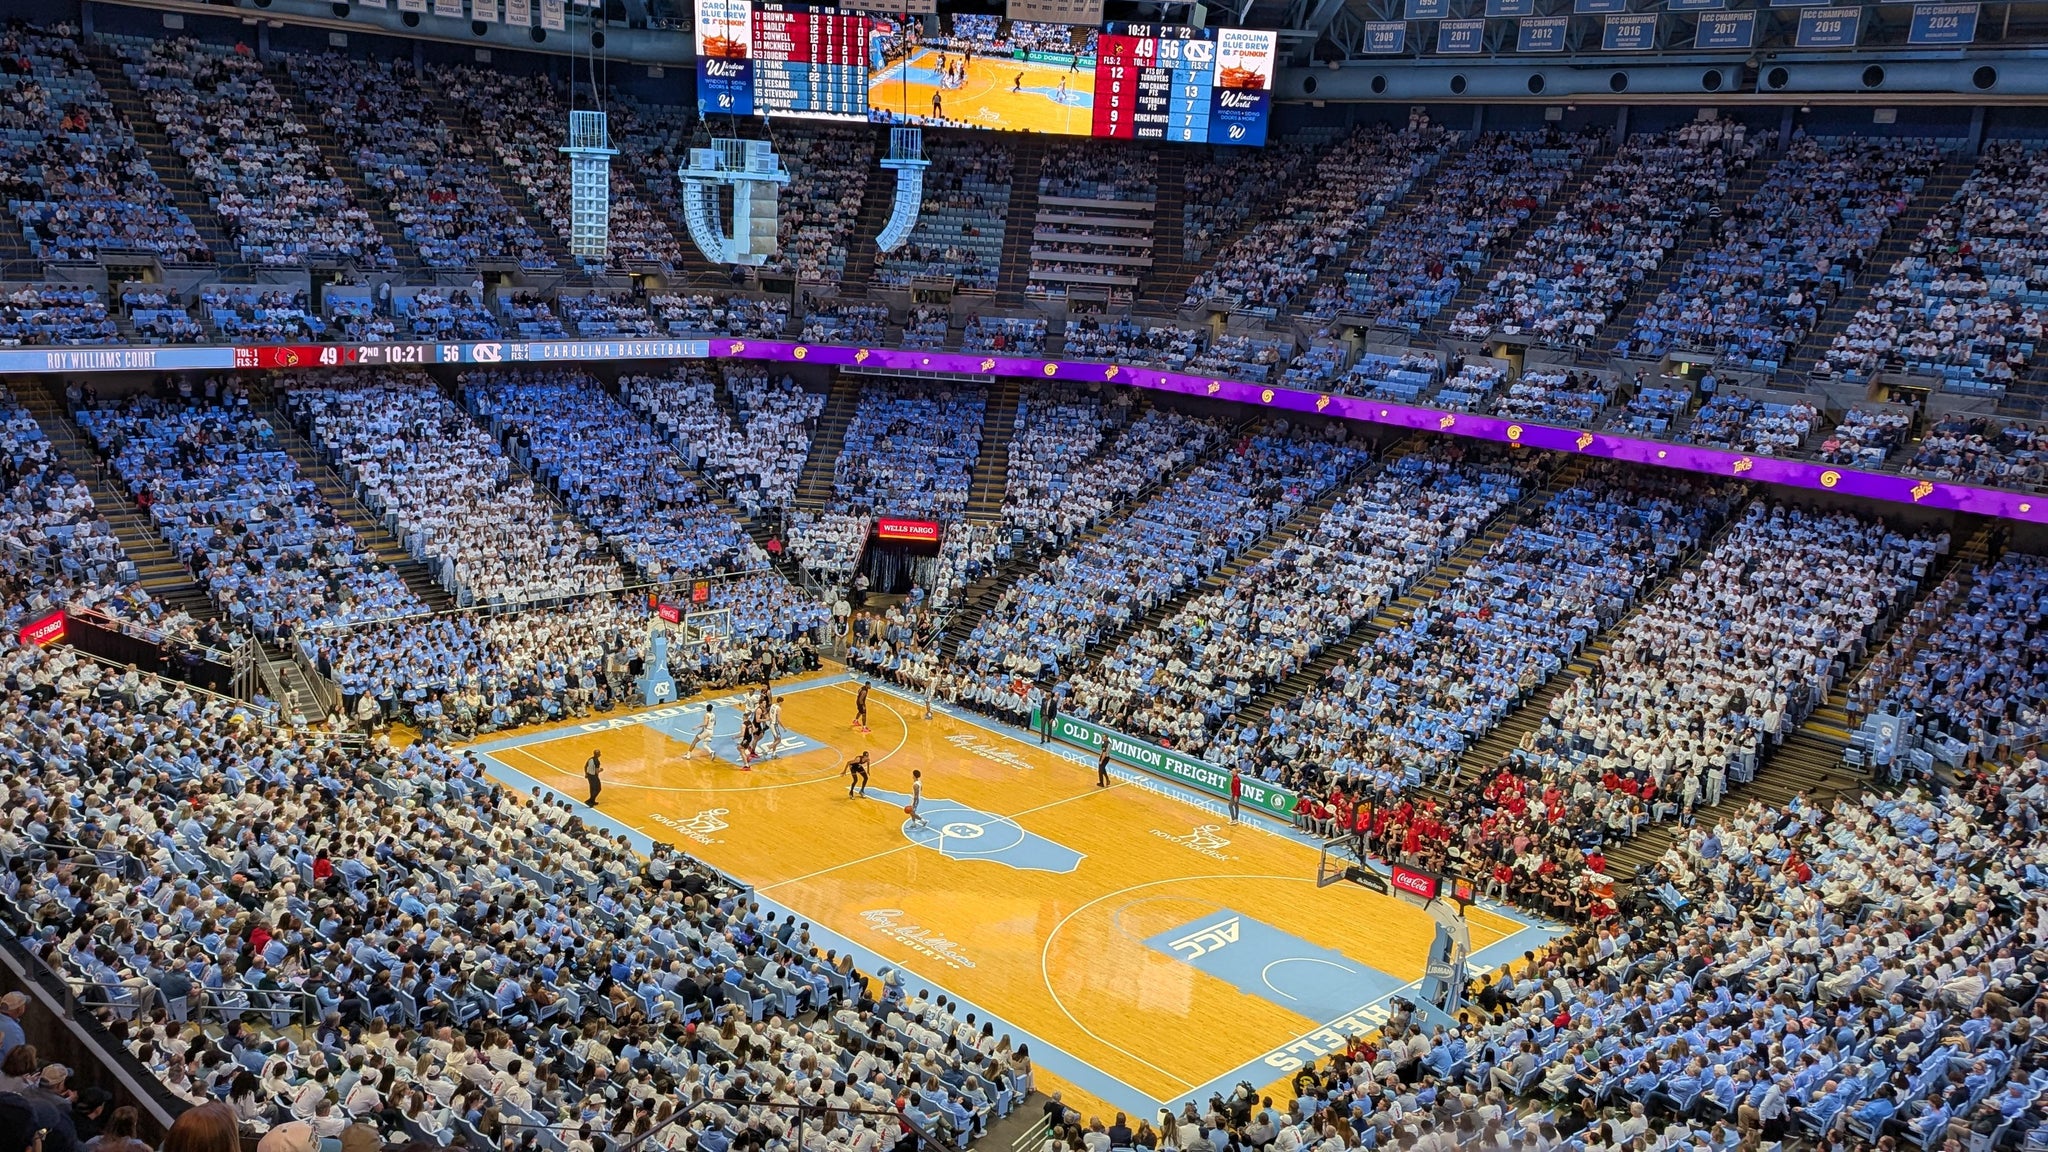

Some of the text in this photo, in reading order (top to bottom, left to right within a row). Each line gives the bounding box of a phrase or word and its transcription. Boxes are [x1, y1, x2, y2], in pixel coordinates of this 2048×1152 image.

[763, 12, 832, 24] BROWN JR. 13 3
[1928, 17, 1958, 28] 2024
[810, 25, 818, 33] 12
[827, 26, 832, 34] 6
[858, 28, 863, 36] 0
[1128, 24, 1150, 36] 10:21
[1180, 28, 1190, 38] 22
[1532, 28, 1552, 38] 2012
[1618, 26, 1640, 36] 2016
[1714, 23, 1737, 34] 2017
[1815, 22, 1841, 32] 2019
[764, 32, 863, 46] CONWELL 12 0
[1225, 33, 1268, 42] CAROLINA
[1375, 32, 1394, 42] 2009
[1452, 32, 1470, 40] 2011
[812, 44, 817, 53] 0
[827, 45, 832, 54] 2
[842, 46, 848, 55] 2
[1135, 39, 1179, 58] 49 56
[812, 54, 817, 62] 2
[827, 55, 832, 63] 2
[842, 56, 848, 64] 0
[858, 57, 863, 65] 0
[764, 71, 819, 81] TRIMBLE 22
[1111, 67, 1123, 78] 12
[1189, 72, 1196, 82] 7
[764, 80, 789, 88] VEESAAR
[1112, 82, 1120, 93] 6
[1185, 86, 1198, 97] 13
[764, 90, 798, 99] STEVENSON
[811, 101, 819, 110] 10
[1111, 96, 1118, 107] 5
[1186, 101, 1193, 112] 7
[1111, 110, 1192, 126] 9 BENCH POINTS 7
[1110, 125, 1191, 140] 7 ASSISTS 9
[237, 348, 252, 357] TOL:
[320, 347, 337, 364] 49
[359, 346, 378, 363] 2ND
[385, 346, 423, 363] 10:21
[444, 346, 458, 362] 56
[544, 344, 696, 358] CAROLINA BASKETBALL
[47, 351, 156, 369] ROY WILLIAMS COURT
[237, 358, 258, 367] FLS: 2
[44, 620, 61, 635] FARGO
[1064, 723, 1264, 803] OLD DMINION FREIGHT INE
[649, 813, 676, 827] novo
[1516, 819, 1524, 829] 8
[1149, 829, 1230, 861] novo nordisk
[1173, 920, 1239, 960] ACC
[896, 936, 945, 960] COURT
[1264, 1004, 1392, 1071] HEELS
